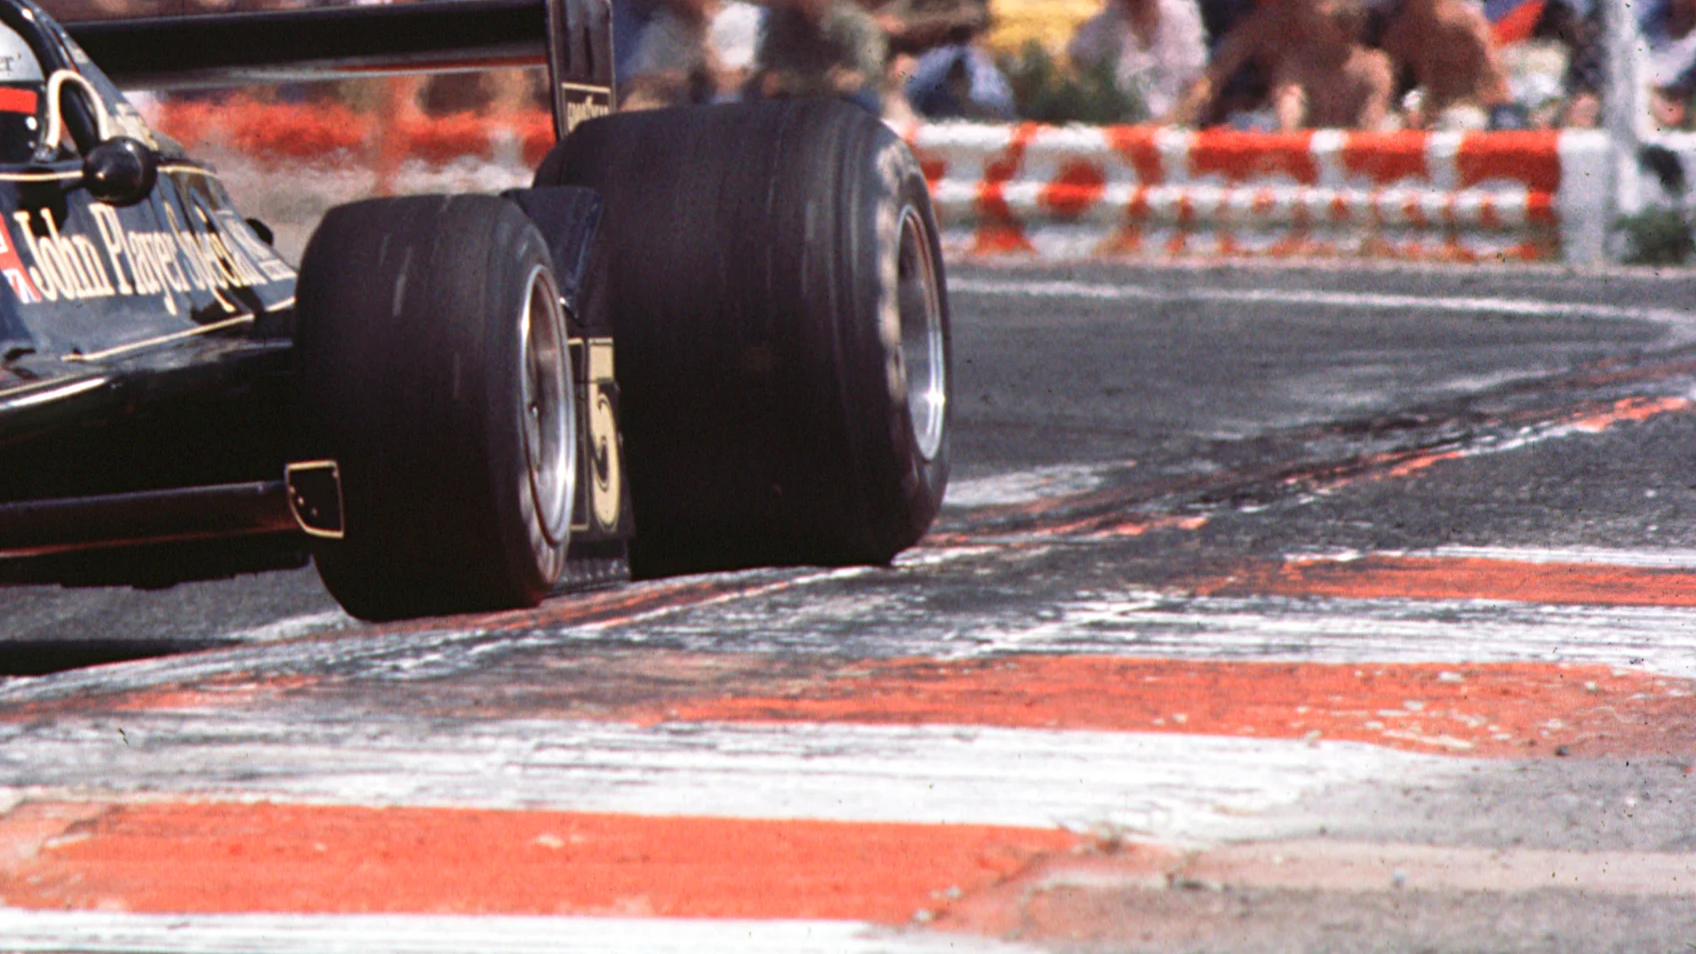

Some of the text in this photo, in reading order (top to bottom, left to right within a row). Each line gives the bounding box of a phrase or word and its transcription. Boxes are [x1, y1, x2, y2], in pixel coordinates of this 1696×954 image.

[12, 206, 117, 302] John
[88, 201, 192, 316] Player
[588, 336, 622, 533] 5
